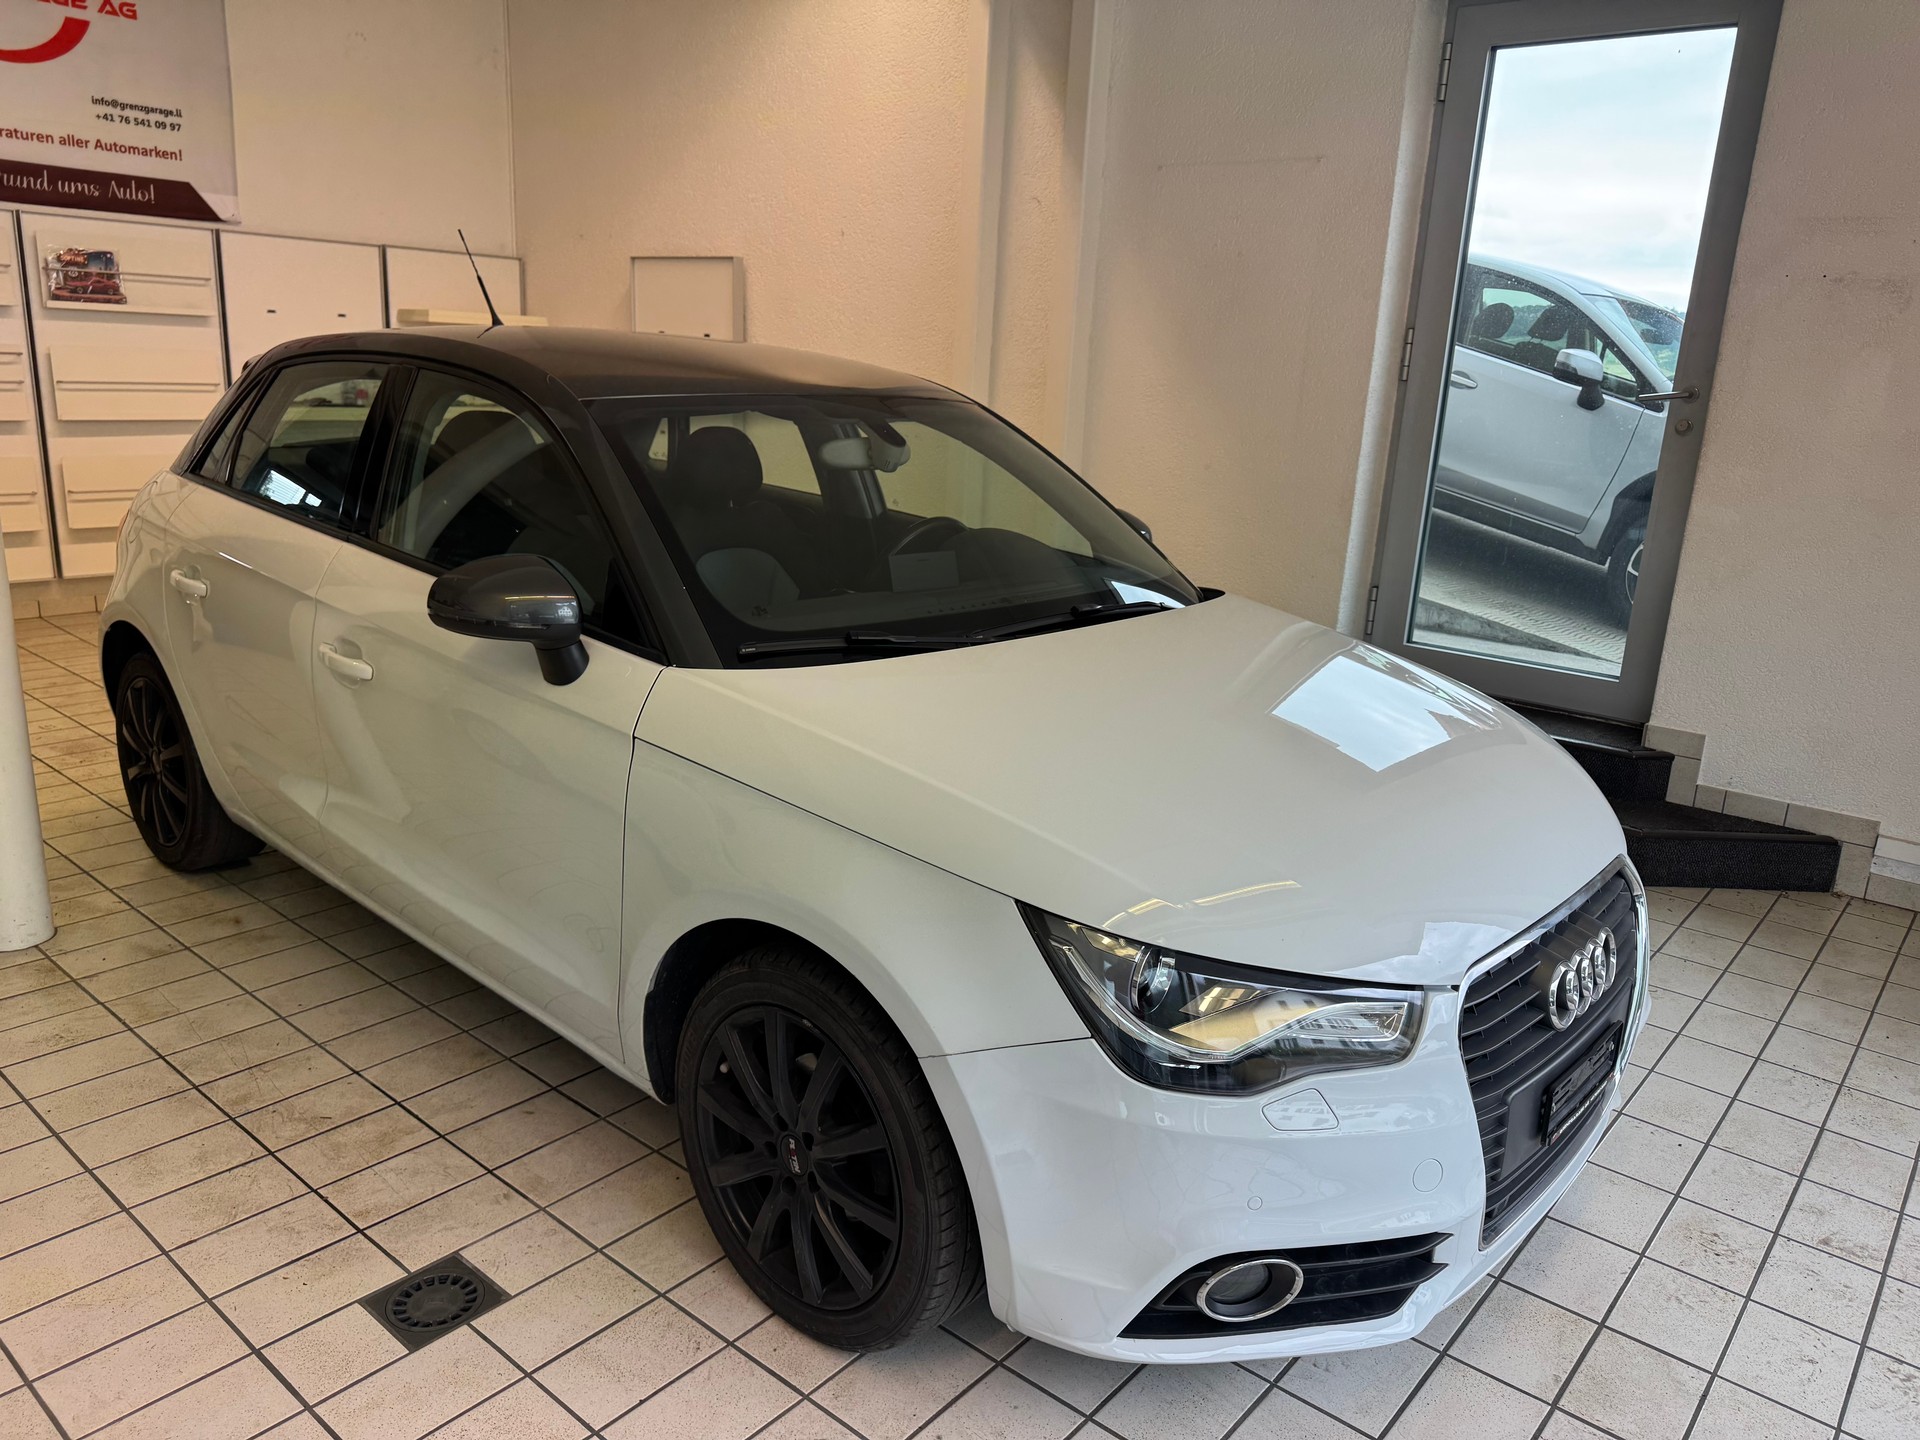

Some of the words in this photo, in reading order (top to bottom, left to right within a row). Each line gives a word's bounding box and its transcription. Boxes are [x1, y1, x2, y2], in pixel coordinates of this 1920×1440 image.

[97, 0, 138, 20] AG
[91, 95, 183, 118] info@grenzgarage.li
[95, 112, 115, 123] +41
[118, 114, 131, 125] 76
[133, 117, 152, 128] 541
[154, 120, 167, 130] 09
[169, 122, 182, 132] 97
[58, 133, 90, 149] aller
[94, 138, 183, 162] Automarken!
[58, 179, 100, 197] ums
